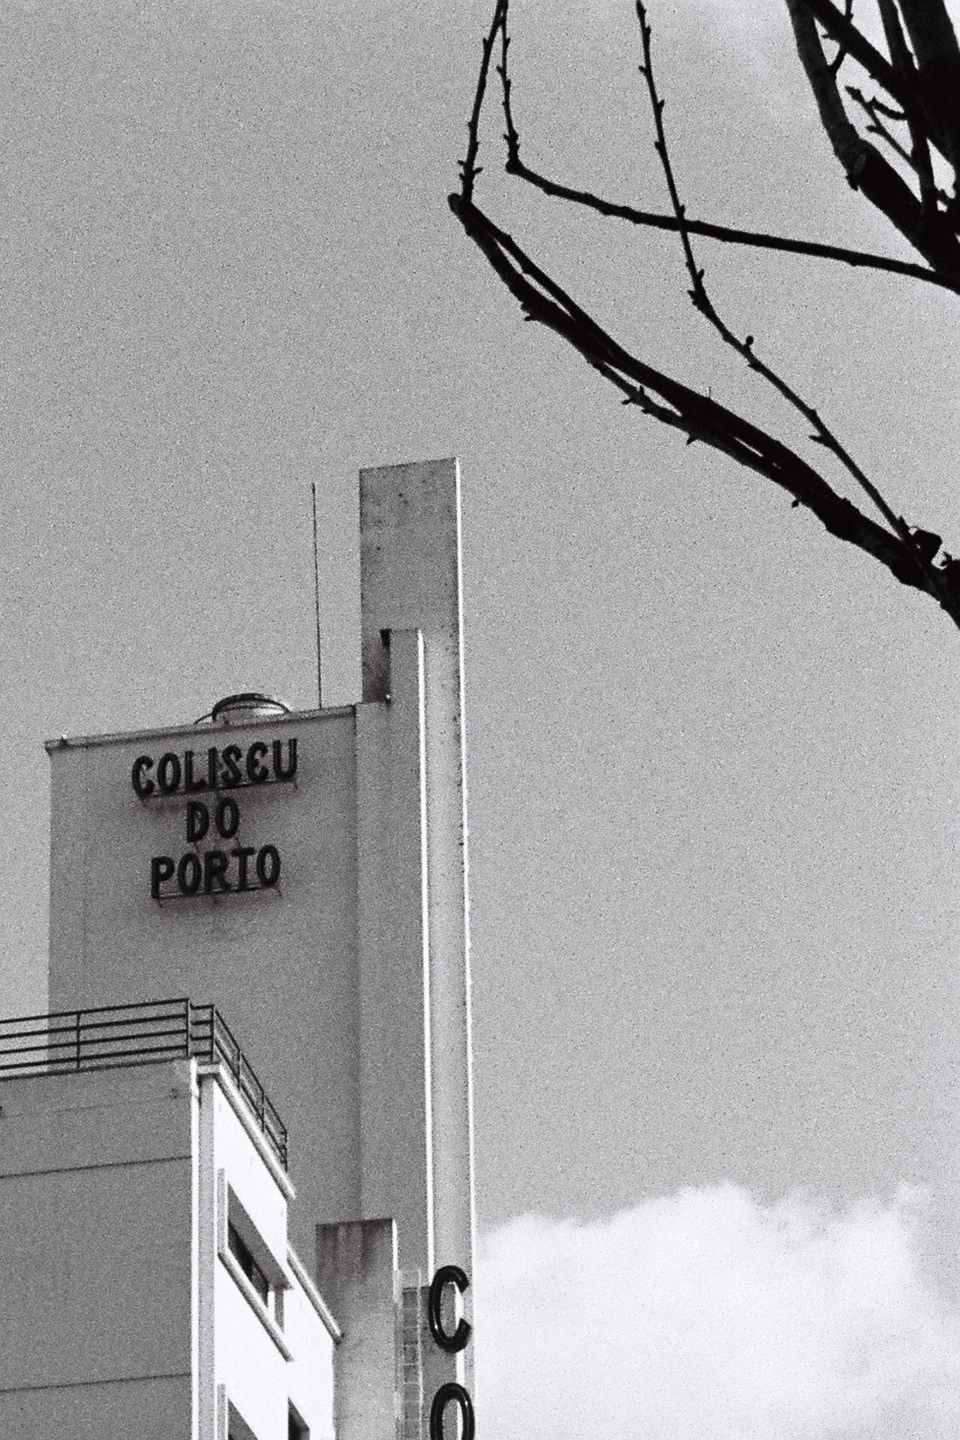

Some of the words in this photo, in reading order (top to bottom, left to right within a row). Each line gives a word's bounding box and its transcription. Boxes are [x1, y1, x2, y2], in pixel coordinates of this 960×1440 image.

[132, 738, 297, 797] COLISEU
[187, 797, 240, 843] DO
[151, 845, 280, 899] PORTO
